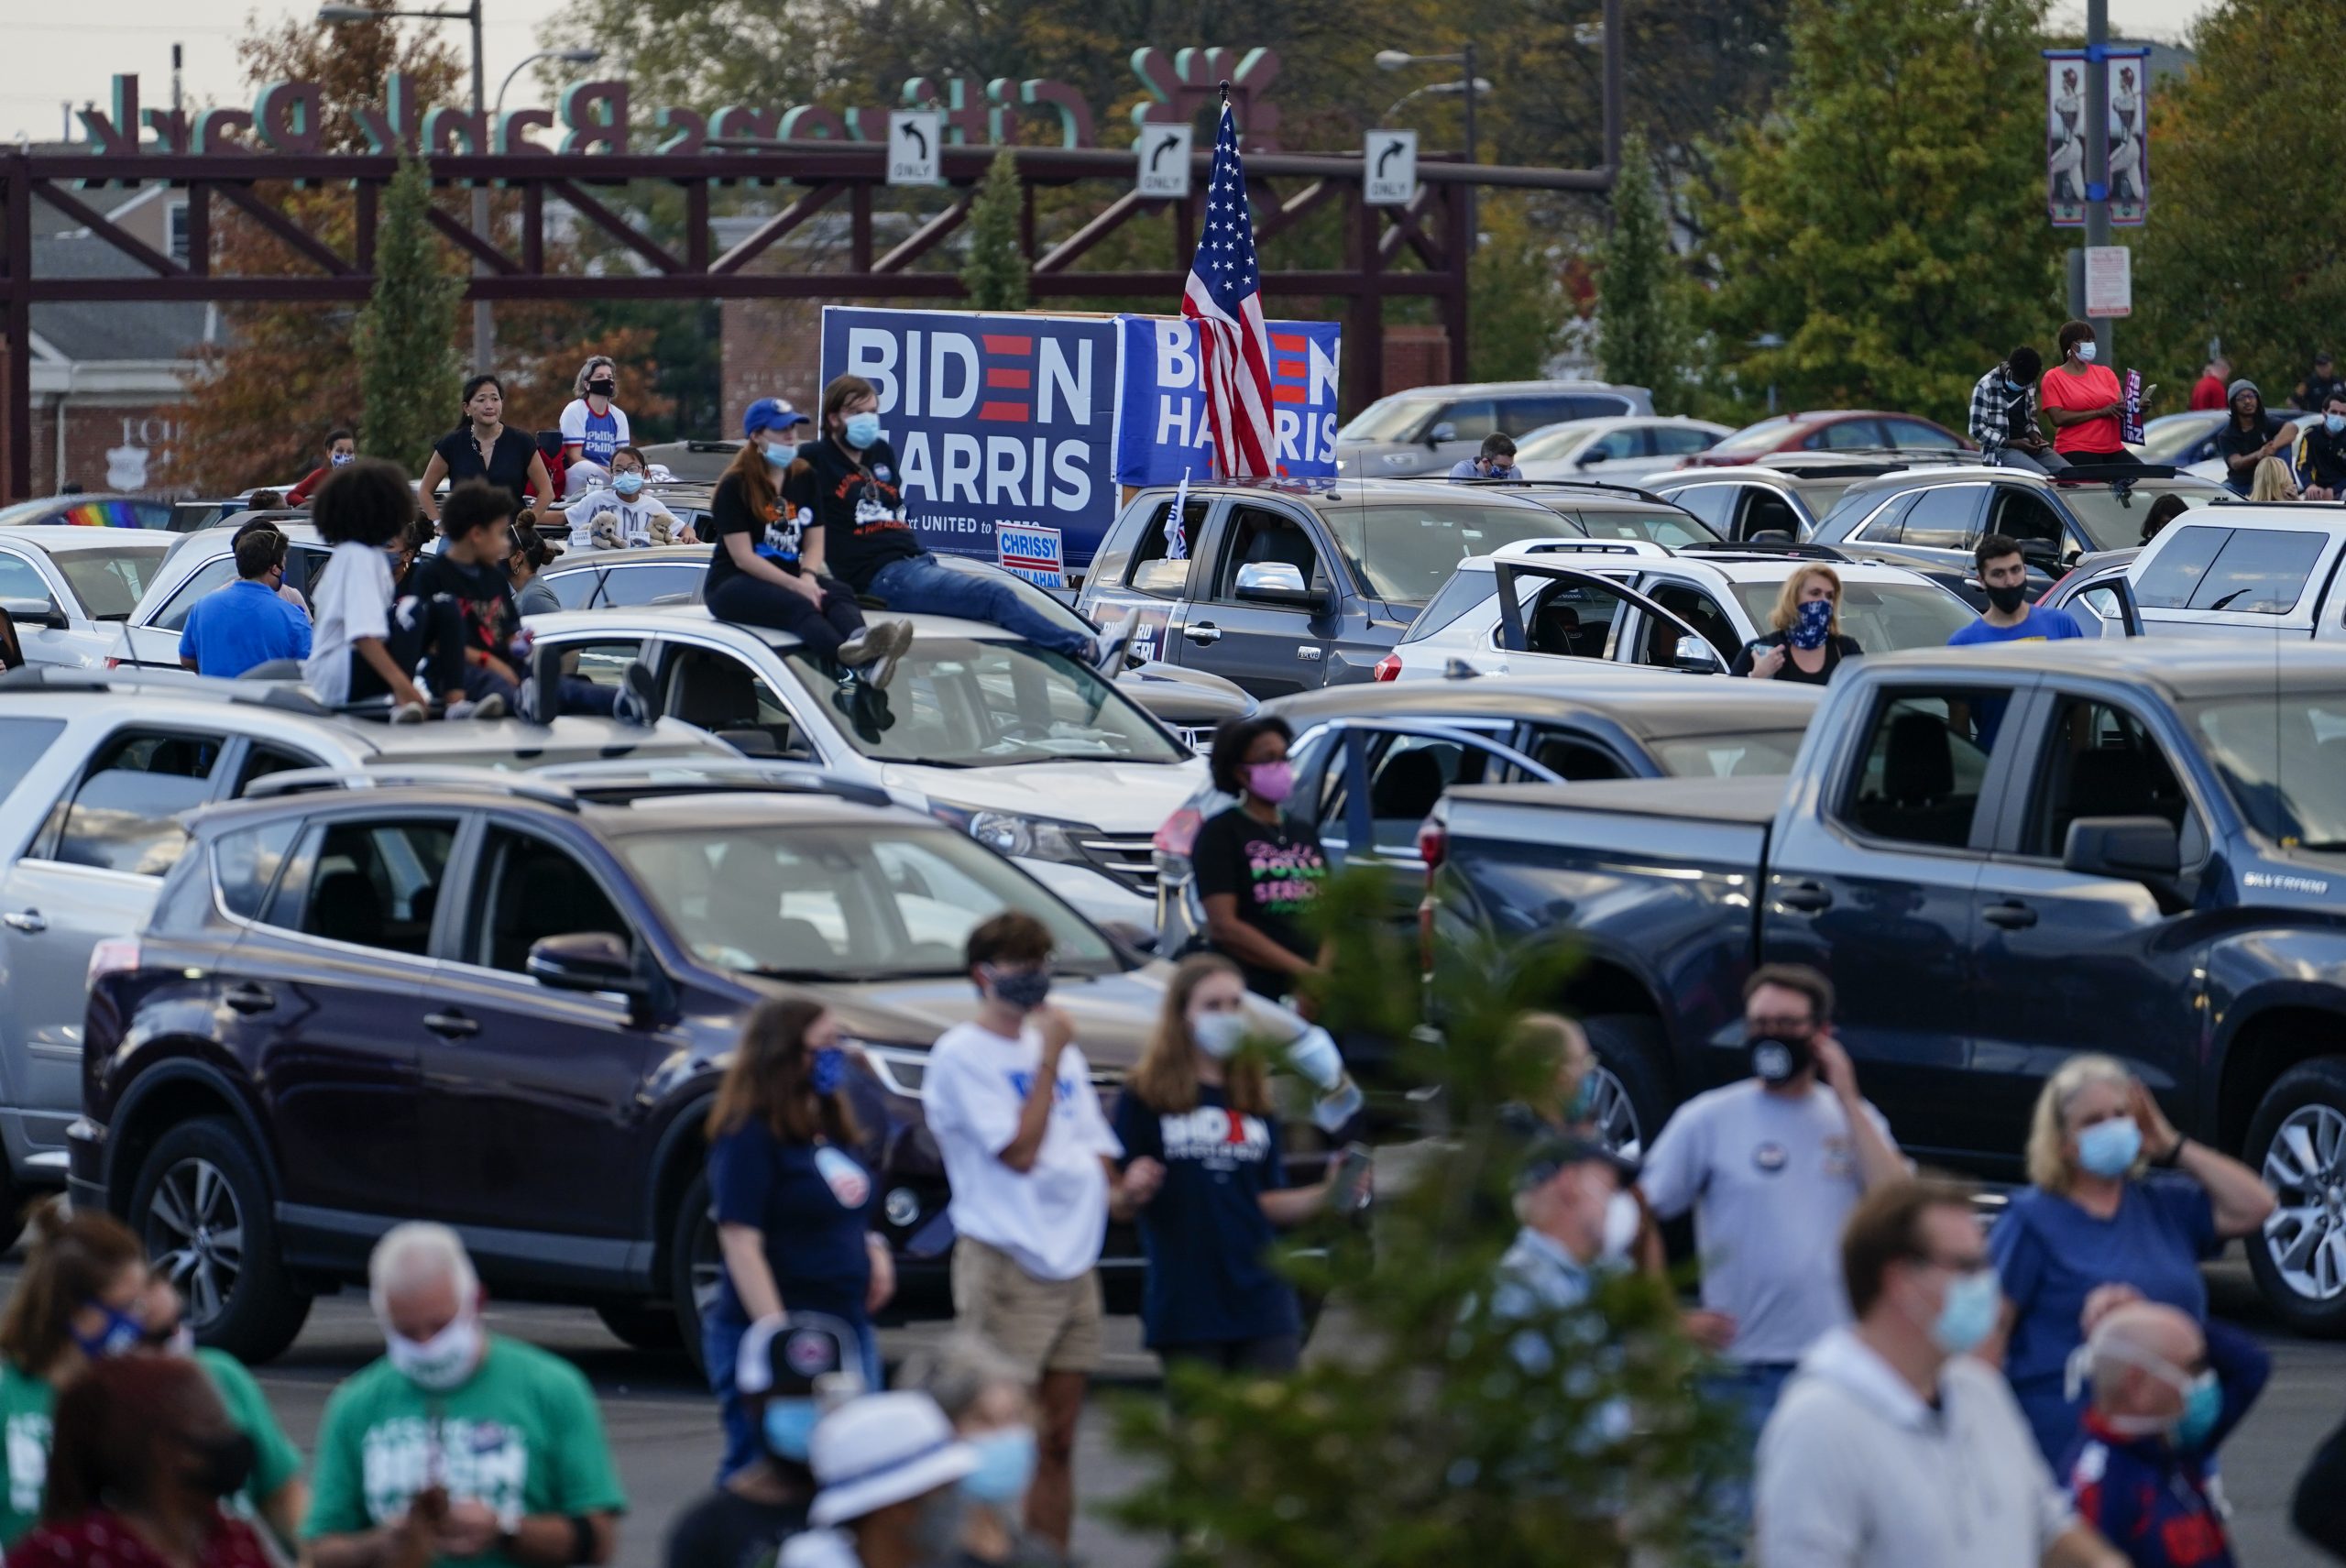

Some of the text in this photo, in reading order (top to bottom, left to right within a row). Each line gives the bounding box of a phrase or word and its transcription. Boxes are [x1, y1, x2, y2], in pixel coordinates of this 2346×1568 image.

[893, 163, 931, 178] ONLY
[847, 327, 1093, 425] BIDEN
[1155, 320, 1341, 406] BEN
[1156, 394, 1338, 464] HARIS
[879, 430, 1092, 512] ARRIS
[922, 514, 977, 533] UNITED
[981, 521, 992, 534] to
[1001, 532, 1058, 559] CHRISSY
[1007, 567, 1060, 587] ULAHAN
